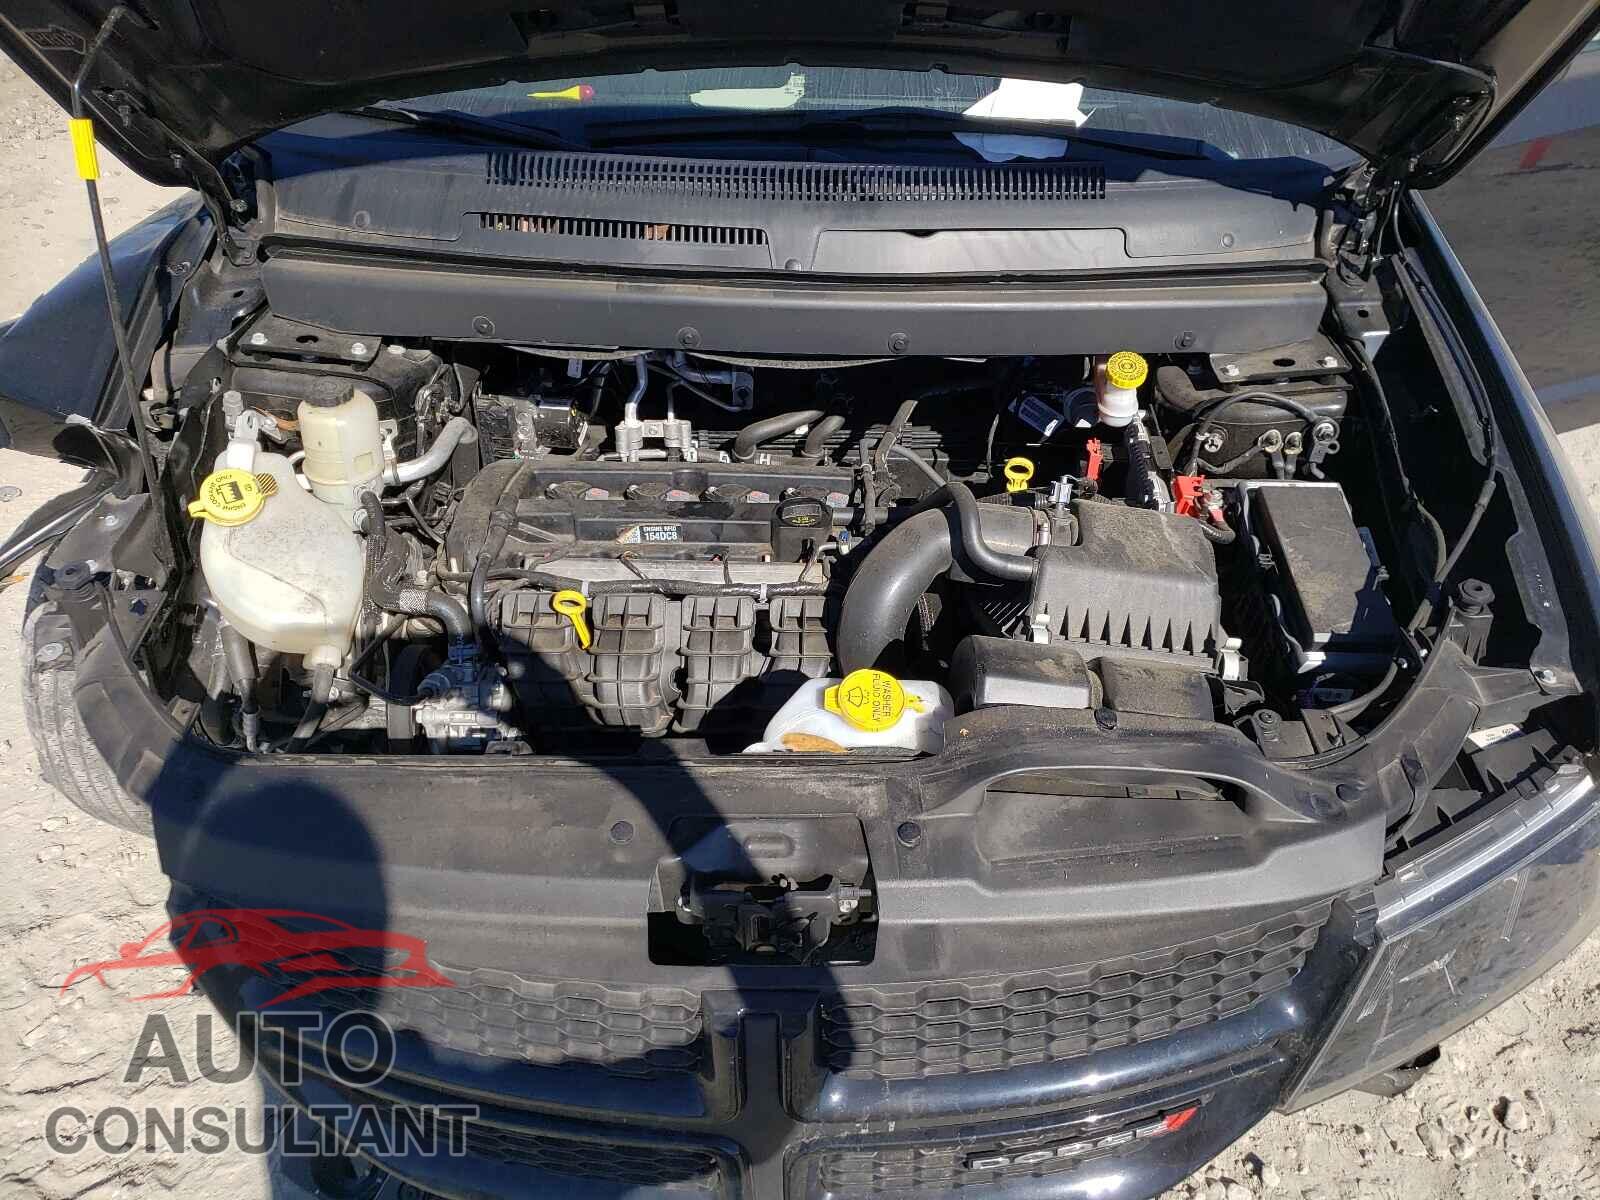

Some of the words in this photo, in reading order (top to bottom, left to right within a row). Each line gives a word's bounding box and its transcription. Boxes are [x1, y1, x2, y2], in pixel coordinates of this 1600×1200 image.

[872, 673, 880, 698] FLUID
[882, 680, 891, 717] WASHER
[872, 701, 880, 722] ONLY
